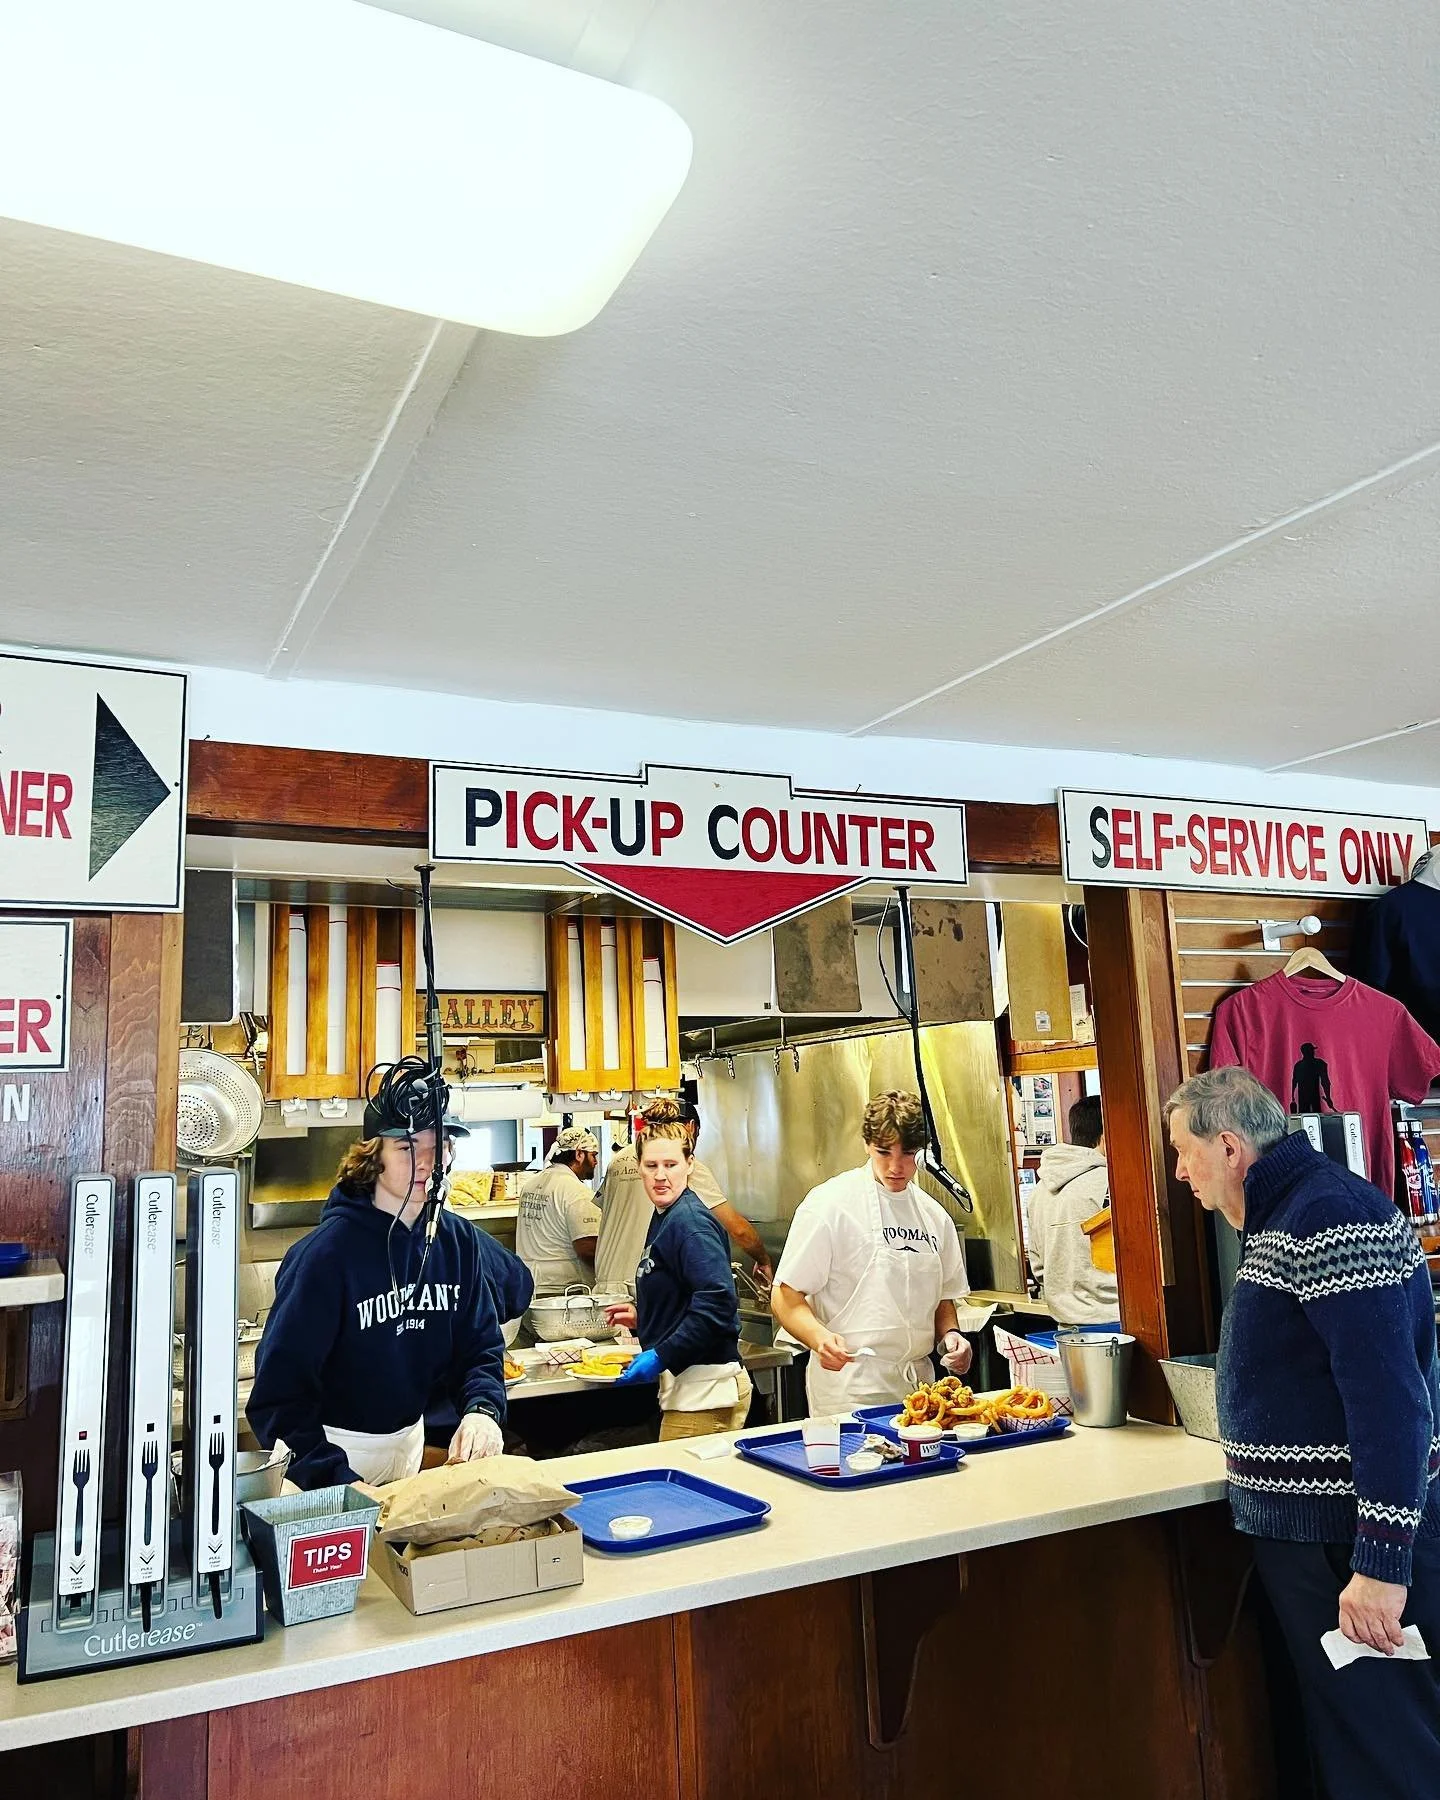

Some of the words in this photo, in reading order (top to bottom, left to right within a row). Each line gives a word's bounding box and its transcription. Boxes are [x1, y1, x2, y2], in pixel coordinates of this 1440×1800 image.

[465, 787, 684, 857] PICK-UP
[707, 804, 937, 872] COUNTER
[1089, 805, 1328, 882] SELF-SERVICE
[1339, 827, 1413, 887] ONLY
[426, 998, 537, 1031] ALLEY
[84, 1193, 100, 1254] Cutlerease
[147, 1191, 163, 1251] Cutlerease
[212, 1187, 227, 1246] Cutlerease
[405, 1318, 426, 1330] 1914
[303, 1541, 352, 1567] TIPS
[83, 1623, 197, 1658] Cutlerease
